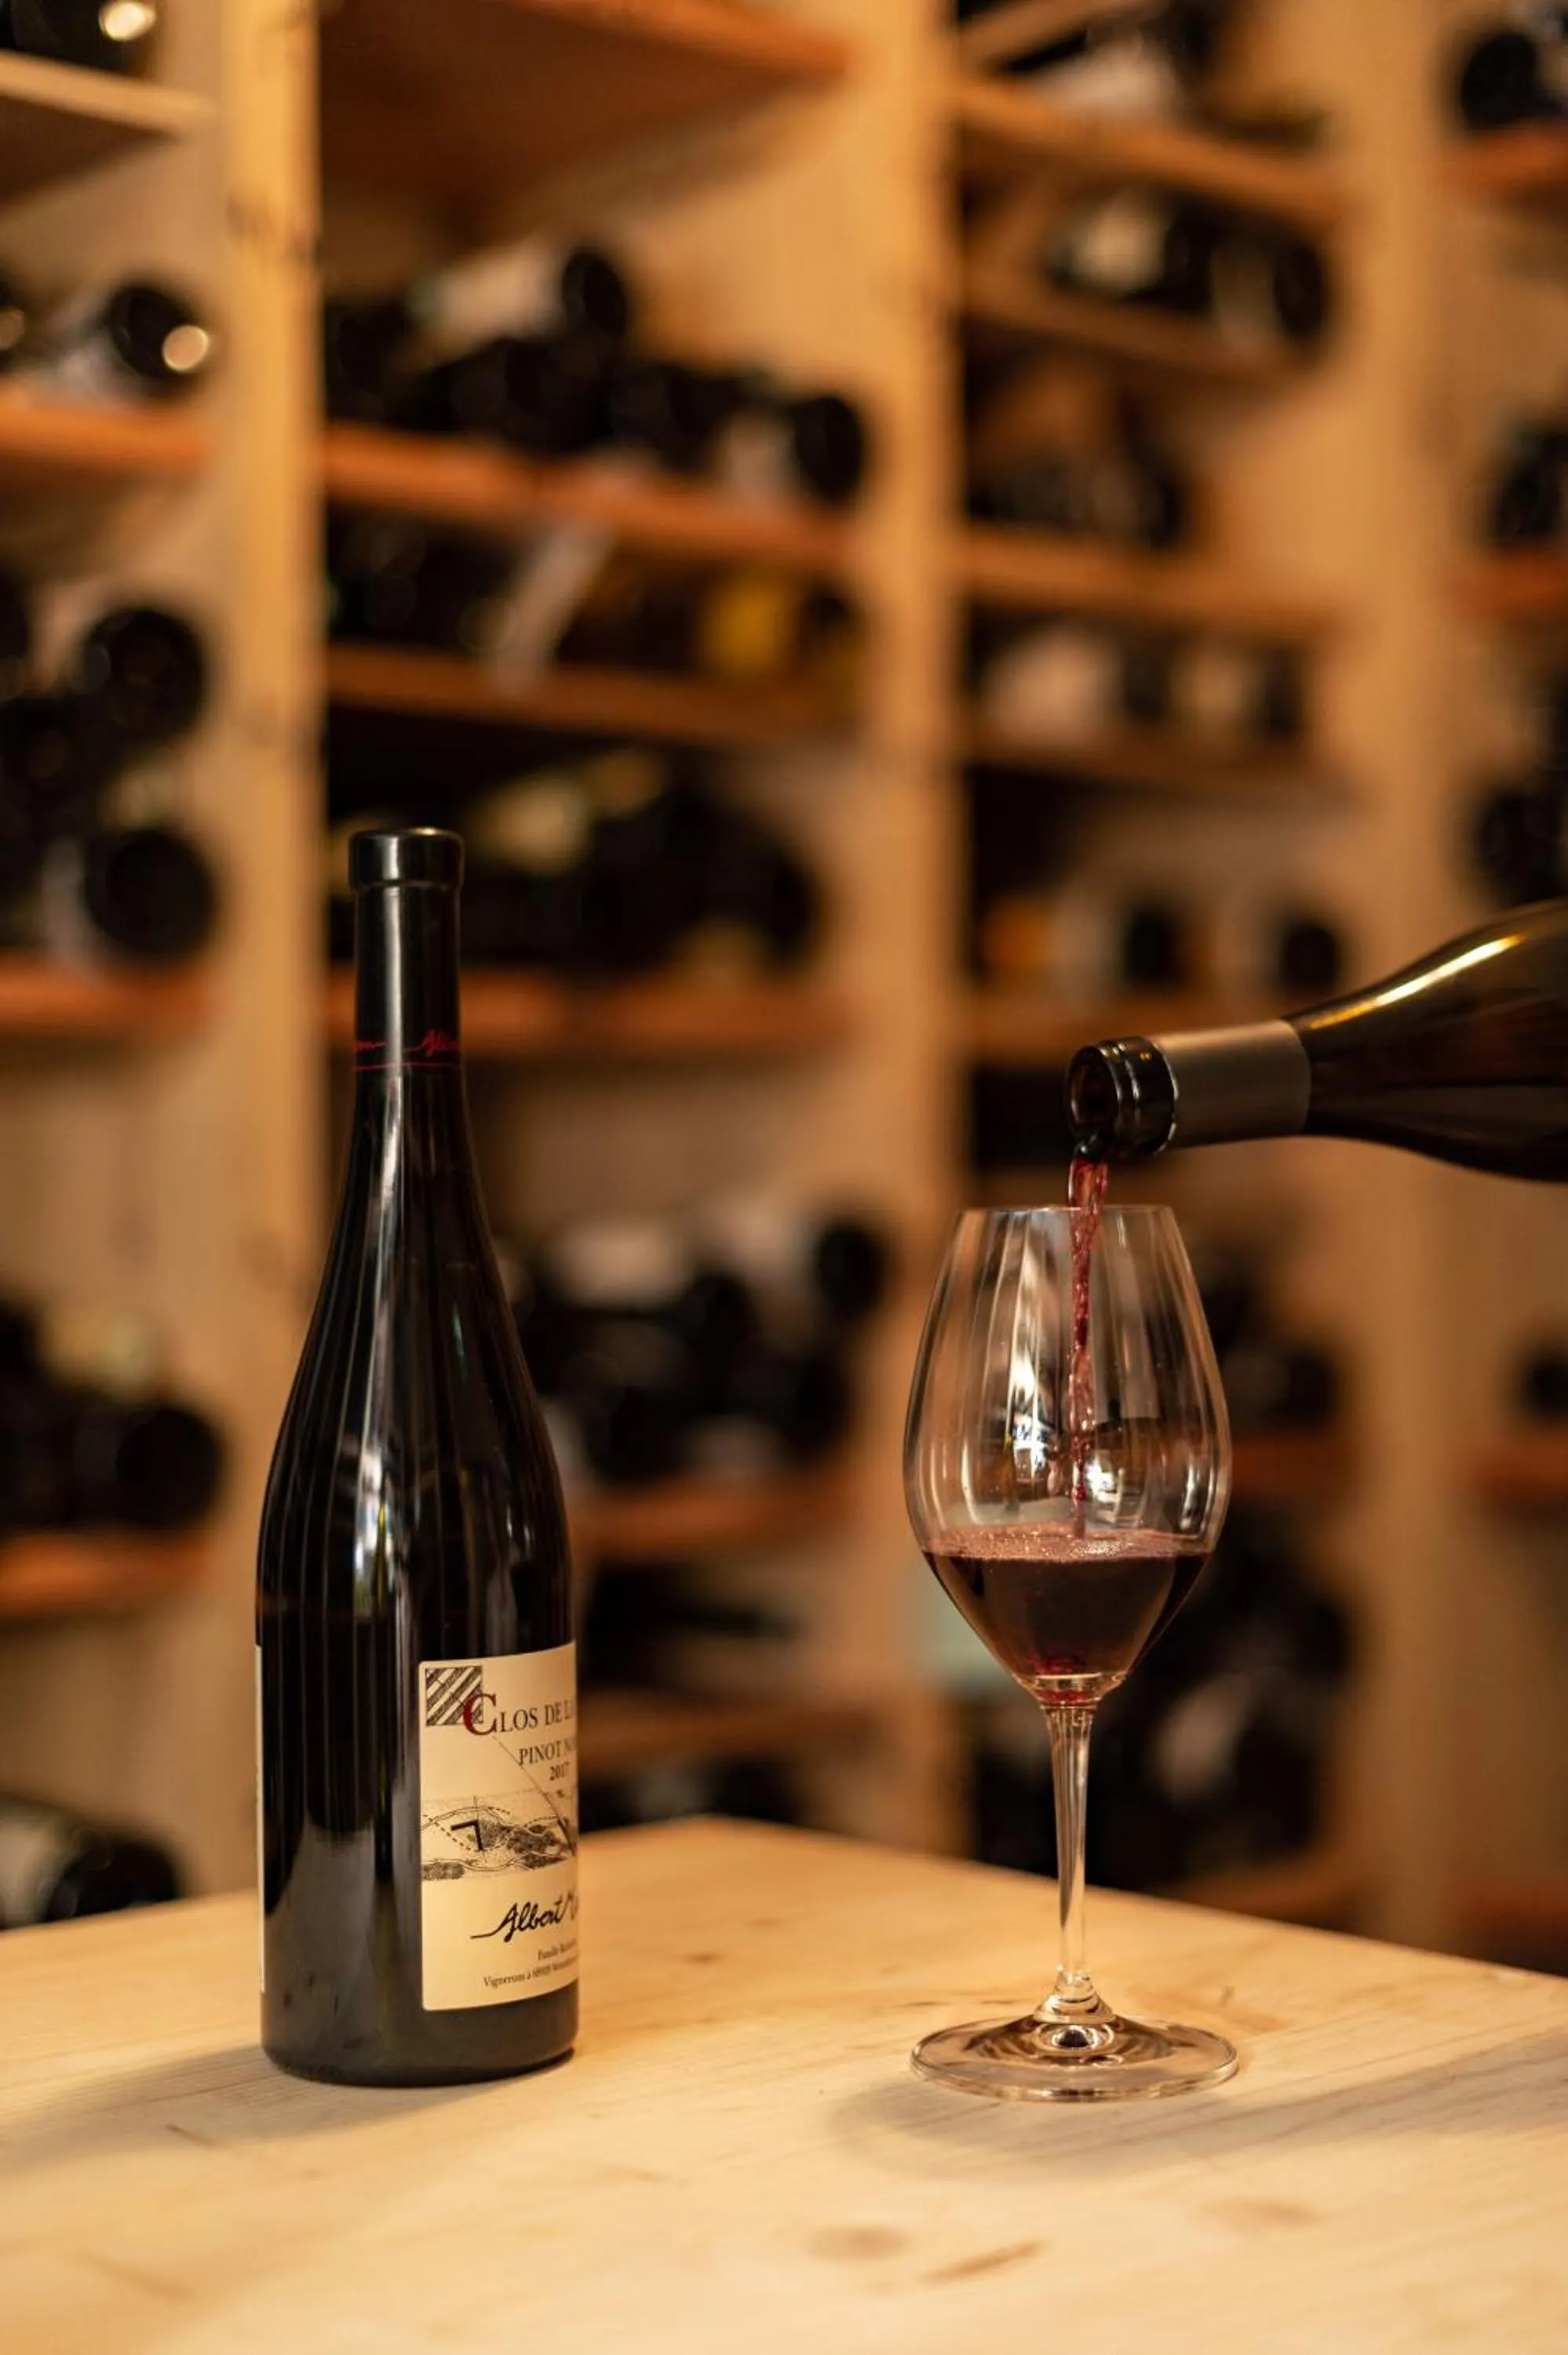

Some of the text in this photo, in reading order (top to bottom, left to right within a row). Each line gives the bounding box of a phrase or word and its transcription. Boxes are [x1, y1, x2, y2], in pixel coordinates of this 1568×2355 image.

[463, 1692, 538, 1736] CLOS
[545, 1701, 563, 1726] DE
[519, 1740, 561, 1766] PINOT
[549, 1762, 570, 1781] 2017
[470, 1893, 563, 1943] Albert
